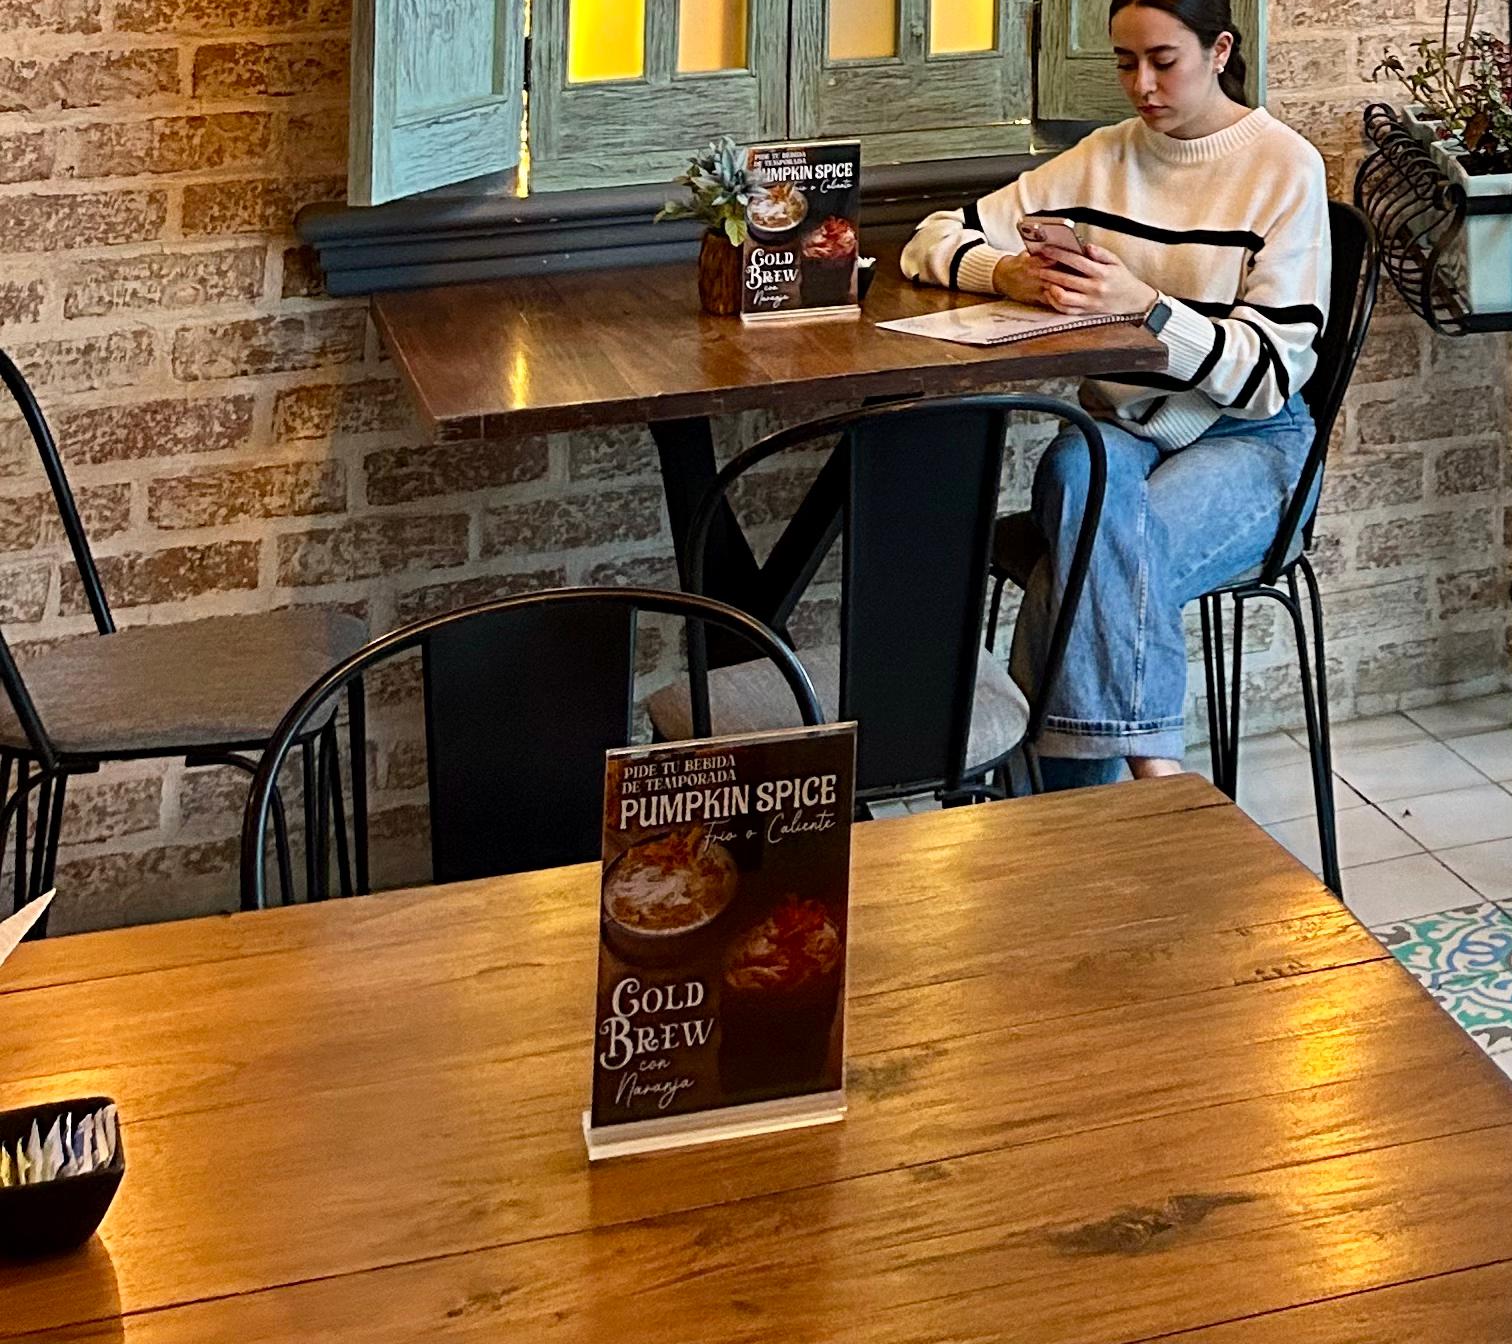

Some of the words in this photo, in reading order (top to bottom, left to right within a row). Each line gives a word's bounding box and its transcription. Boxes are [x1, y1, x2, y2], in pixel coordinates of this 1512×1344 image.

[815, 162, 853, 179] SPICE
[751, 248, 794, 266] COLD
[746, 265, 799, 290] BREW
[624, 763, 658, 779] PIDE
[662, 761, 681, 775] TU
[685, 754, 736, 772] BEBIDA
[621, 780, 644, 794] DE
[647, 769, 737, 792] TEMPORADA
[620, 784, 750, 829] PUMPKIN
[756, 775, 837, 811] SPICE
[767, 809, 836, 845] Caliente
[612, 977, 704, 1018] COLD
[599, 1017, 715, 1071] BREW
[639, 1060, 672, 1072] con
[614, 1071, 695, 1110] Naranja
